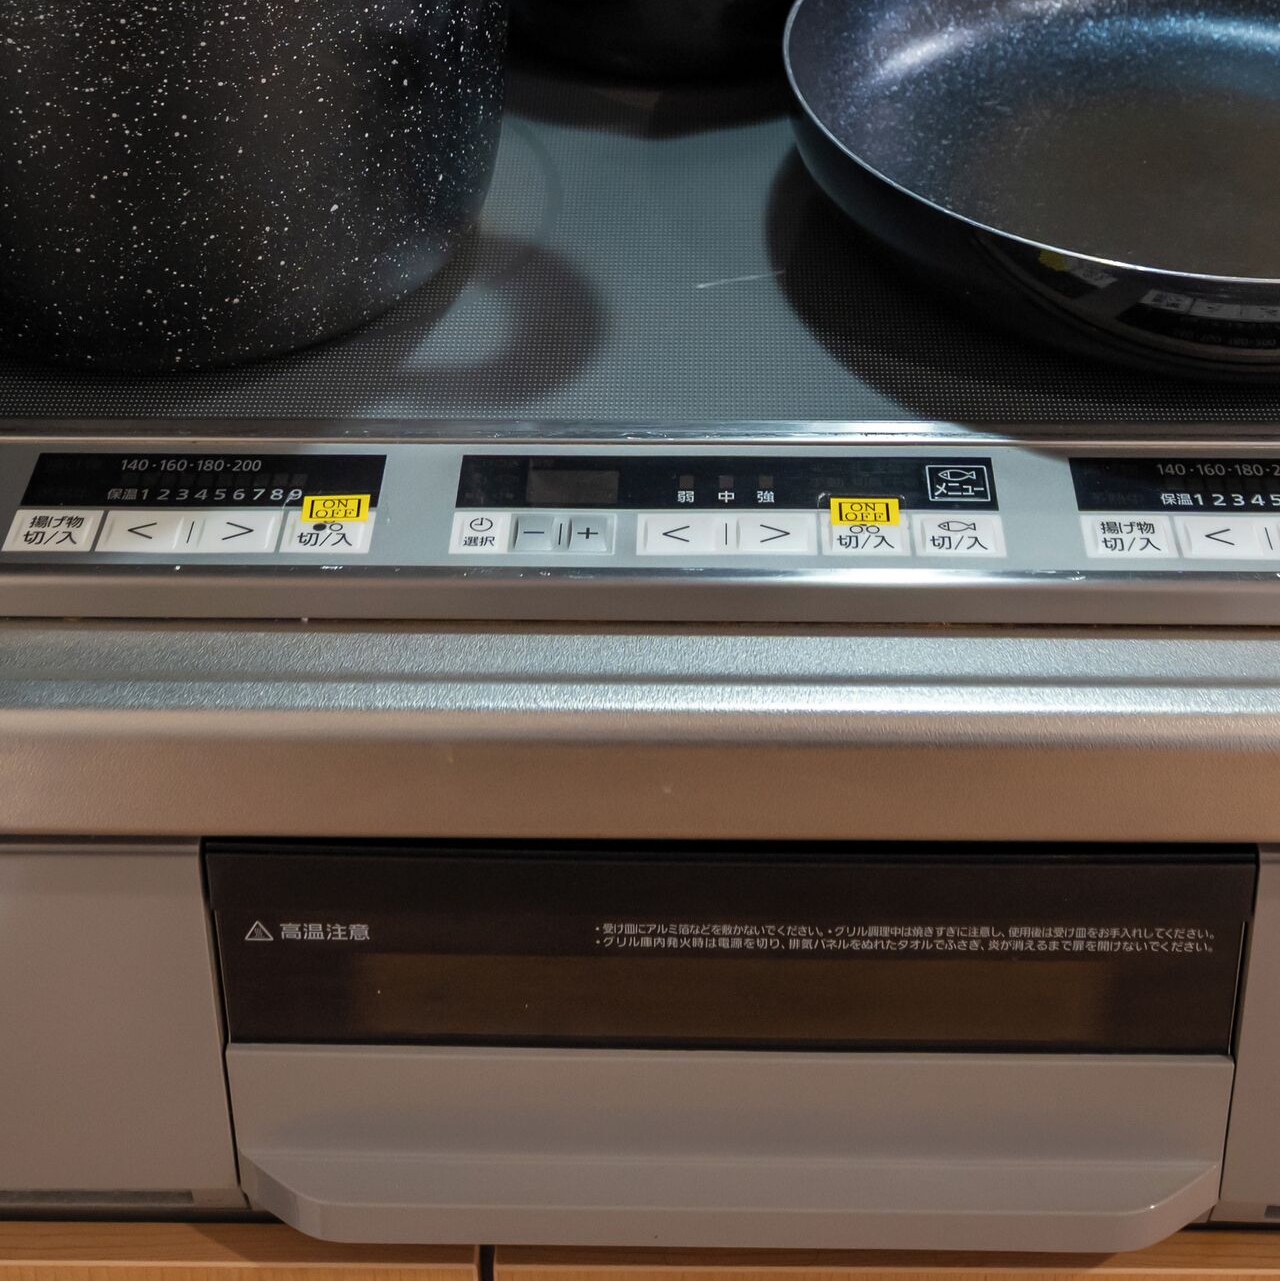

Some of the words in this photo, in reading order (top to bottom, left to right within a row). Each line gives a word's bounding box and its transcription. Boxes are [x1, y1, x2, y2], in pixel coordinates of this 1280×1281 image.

[934, 482, 985, 496] メニュー
[677, 490, 695, 503] 弱
[718, 490, 735, 503] 中
[756, 490, 775, 503] 強
[1160, 492, 1193, 506] 保温
[322, 499, 349, 509] ON
[850, 503, 876, 512] ON
[315, 509, 355, 518] OFF
[844, 512, 884, 521] OFF
[28, 515, 84, 529] 揚げ物
[1100, 521, 1156, 535] 揚げ物
[22, 530, 77, 545] 切/入
[297, 532, 353, 546] 切/入
[462, 535, 495, 547] 選択
[836, 534, 895, 549] 切/入
[929, 535, 989, 550] 切/入
[1102, 536, 1162, 552] 切/入
[279, 923, 370, 941] 高温注意
